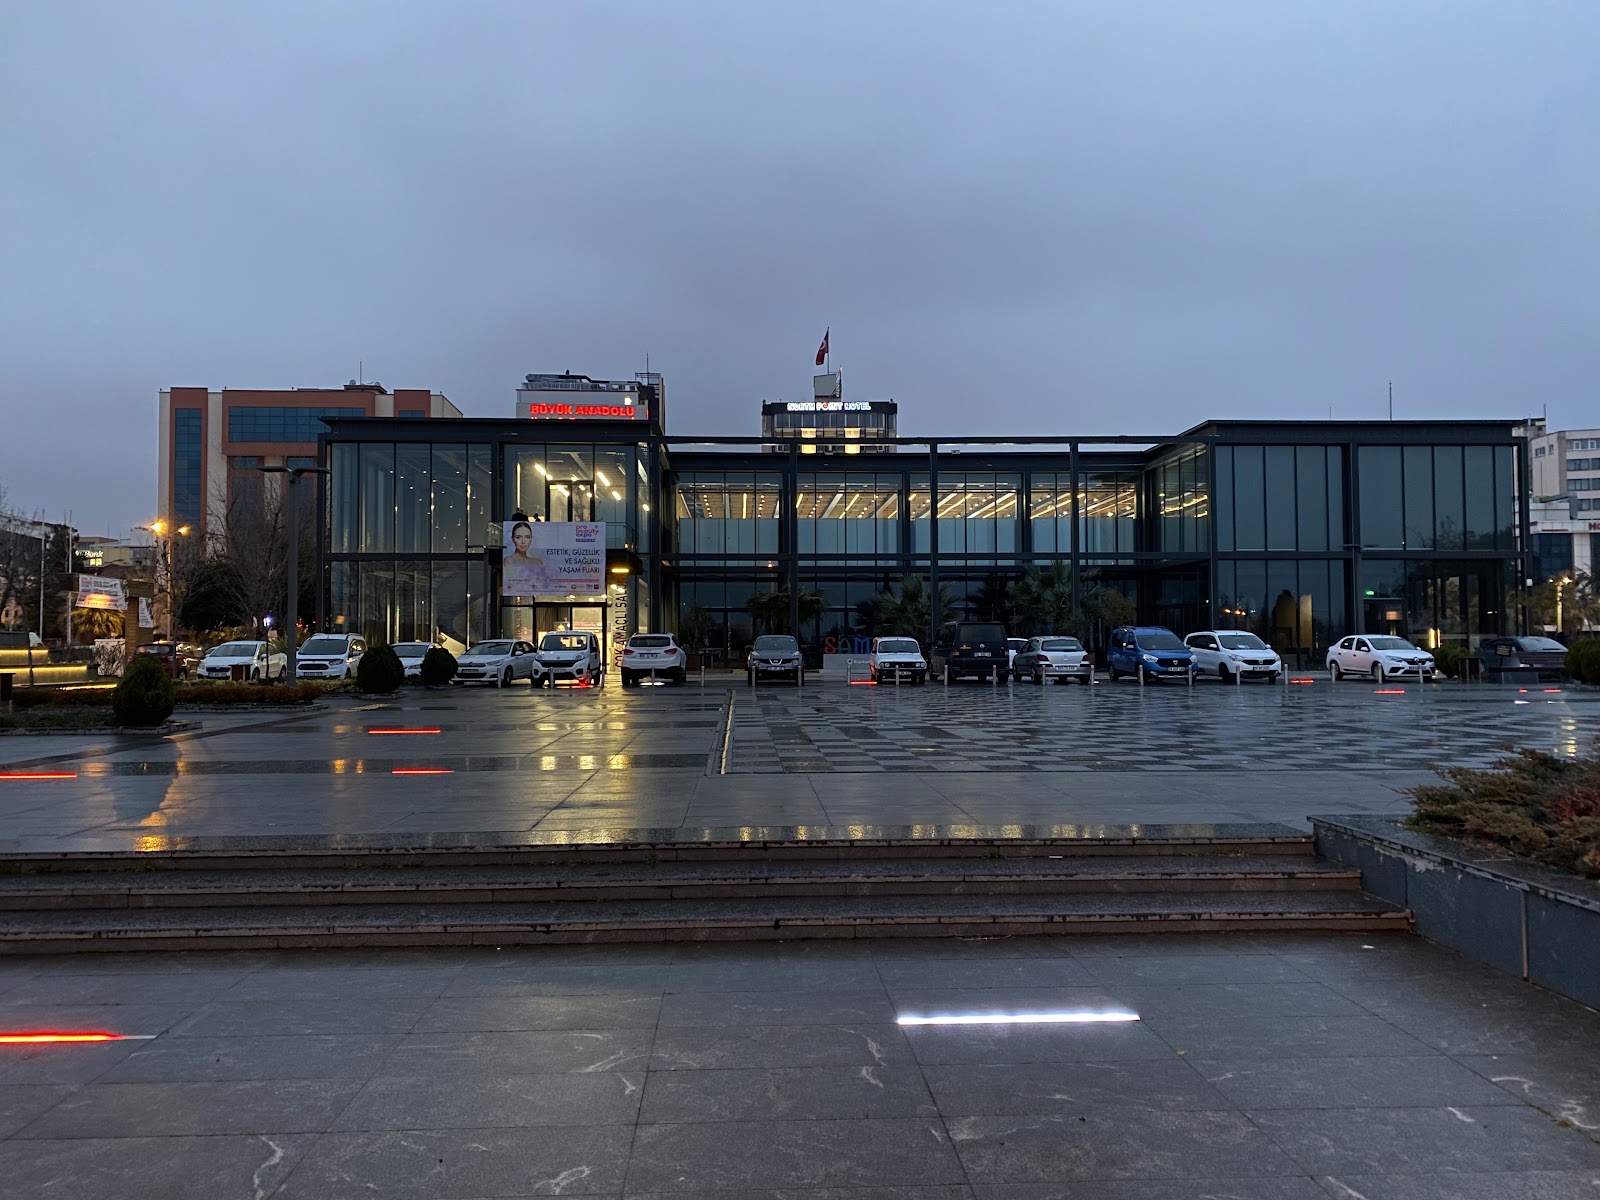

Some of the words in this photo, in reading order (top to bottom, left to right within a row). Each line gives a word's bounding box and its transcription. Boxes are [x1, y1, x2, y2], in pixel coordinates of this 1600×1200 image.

[530, 403, 572, 415] BÜYÜK
[576, 405, 635, 416] ANADOLU
[787, 402, 815, 411] NORTH
[816, 402, 843, 411] POINT
[844, 402, 871, 411] HOTEL
[546, 548, 571, 556] ESTETİK,
[572, 547, 600, 556] GÜZELLİK
[575, 557, 600, 565] SAĞLIKLI
[615, 610, 628, 645] AMAÇLI
[824, 637, 870, 654] SAM
